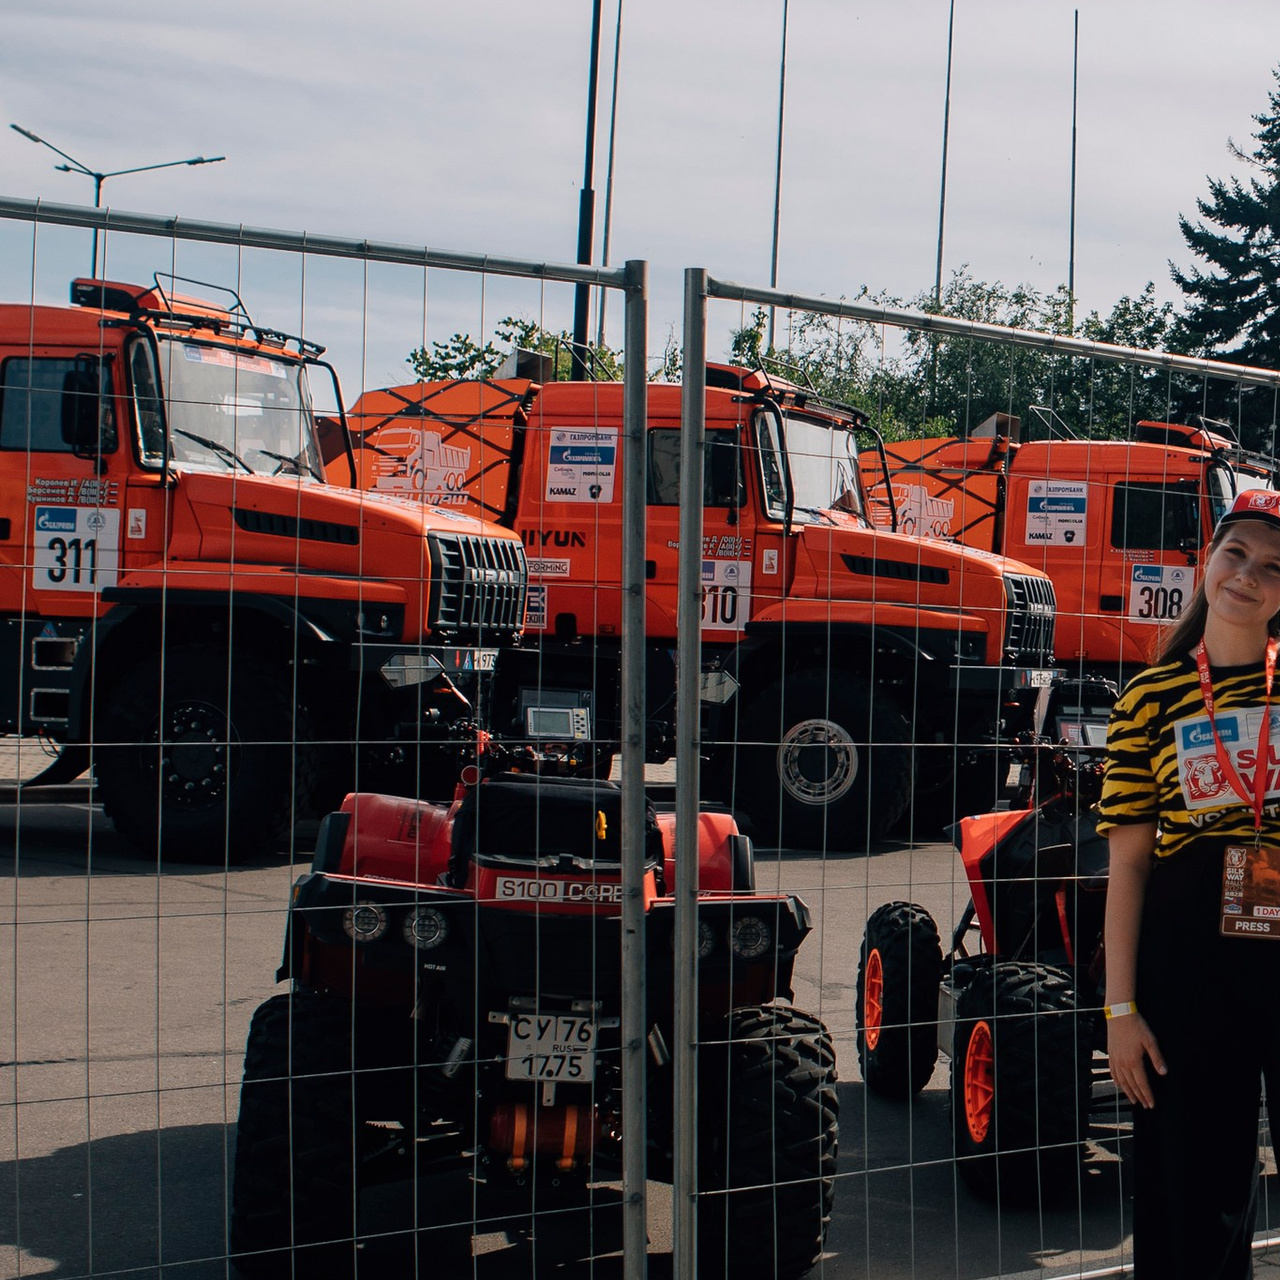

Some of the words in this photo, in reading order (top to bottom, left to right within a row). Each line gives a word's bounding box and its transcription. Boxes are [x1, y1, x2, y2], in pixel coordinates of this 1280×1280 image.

[549, 487, 576, 495] KAMAZ
[1028, 532, 1053, 540] KAMAZ
[47, 537, 96, 584] 311
[1138, 586, 1183, 619] 308
[502, 880, 557, 898] S100
[1262, 908, 1280, 916] DAY
[1235, 921, 1270, 932] PRESS
[562, 1020, 592, 1042] 76
[552, 1045, 573, 1053] RUS
[521, 1053, 582, 1077] 1775
